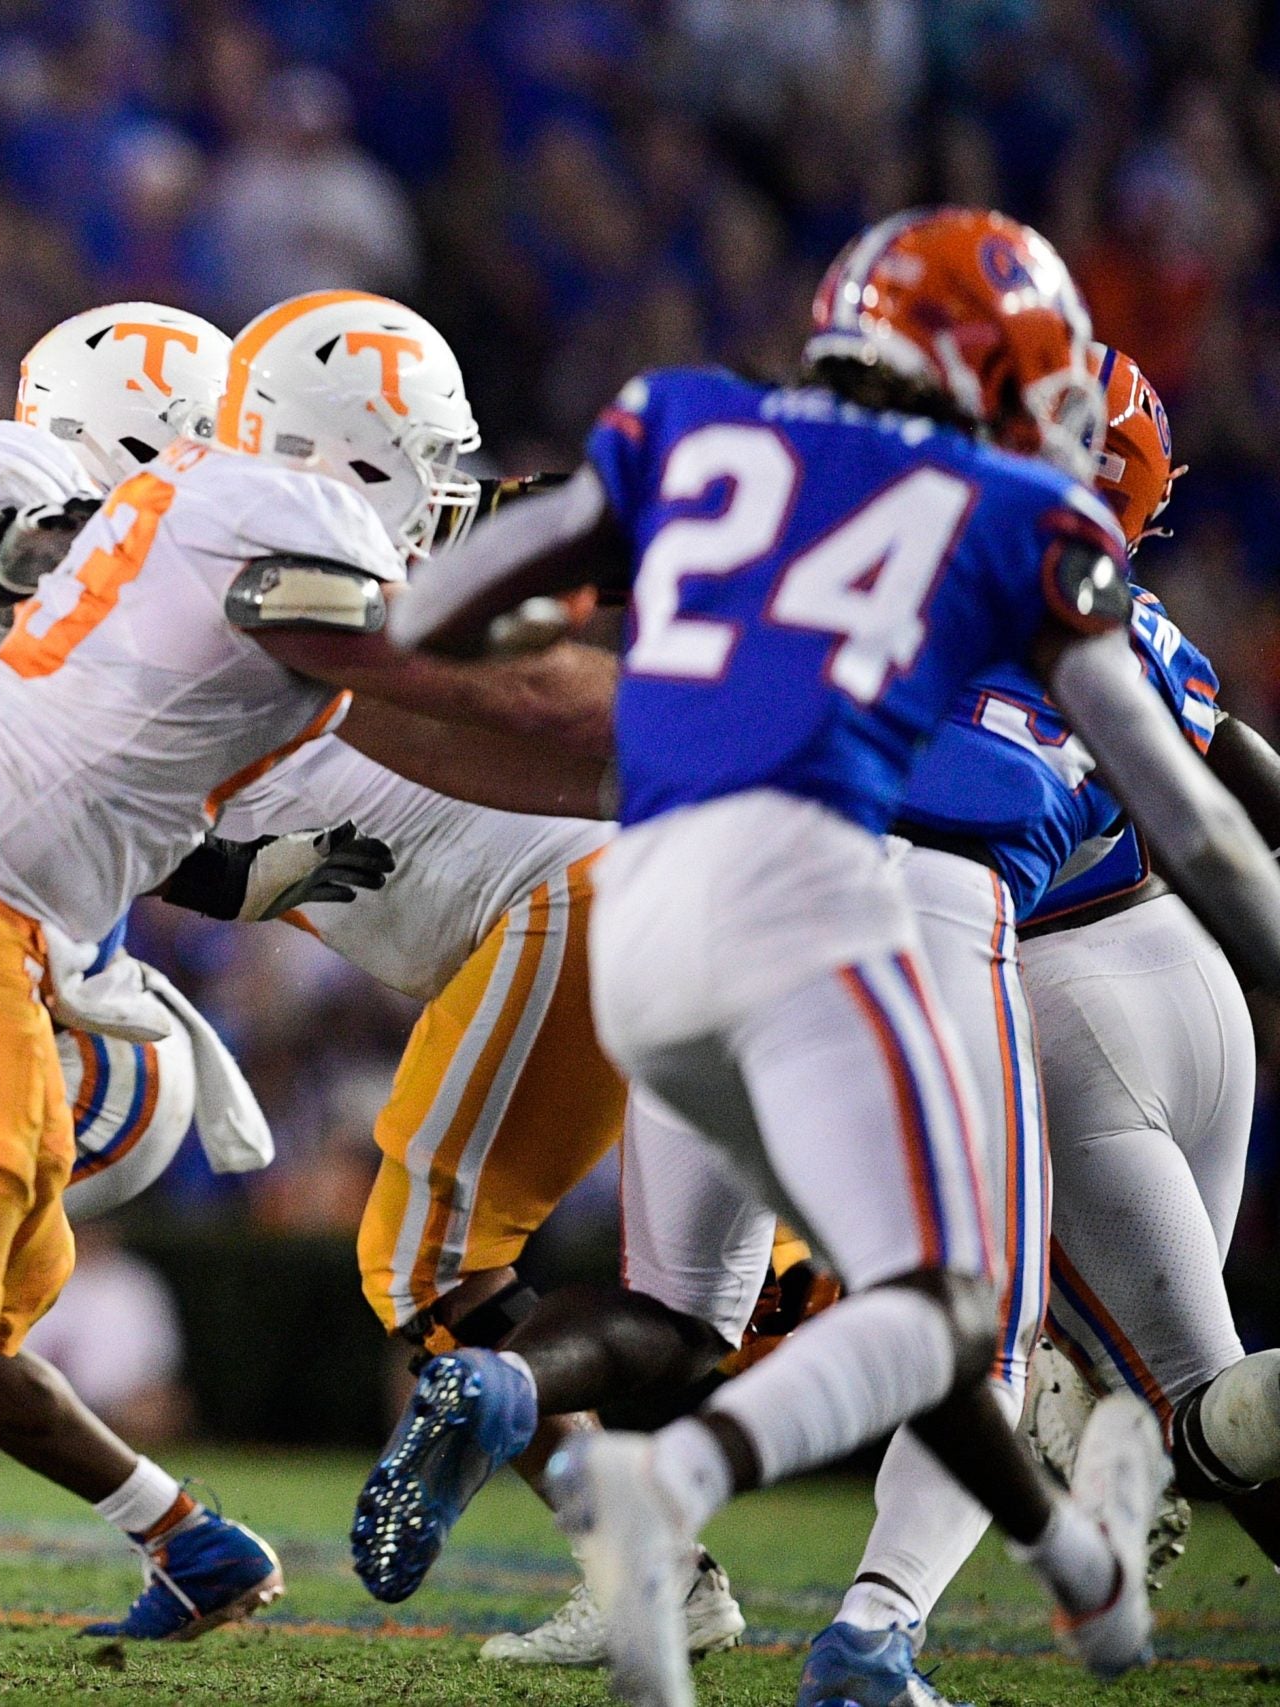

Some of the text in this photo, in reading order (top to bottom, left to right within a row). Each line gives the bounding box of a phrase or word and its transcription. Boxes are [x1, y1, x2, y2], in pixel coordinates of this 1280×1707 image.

[114, 322, 199, 397] T
[345, 332, 424, 416] T
[242, 412, 263, 455] 3
[625, 422, 978, 707] 24
